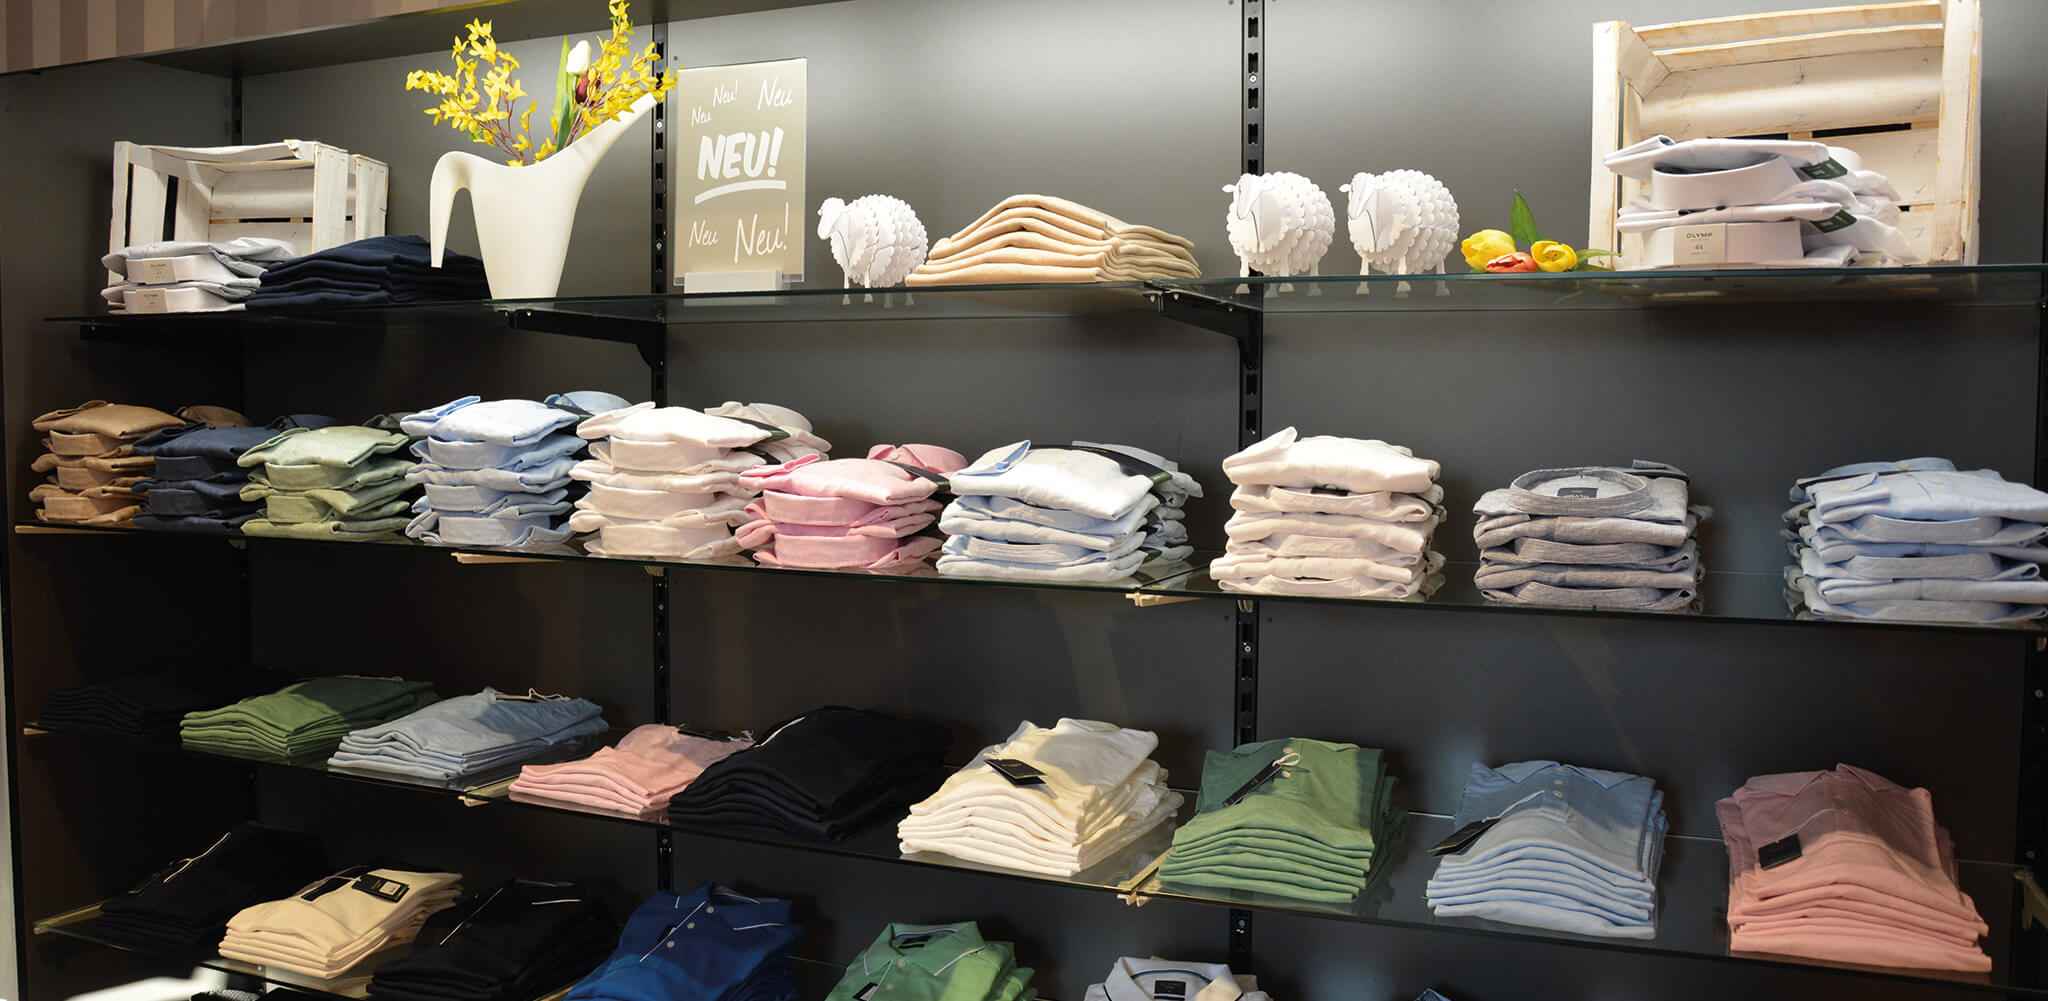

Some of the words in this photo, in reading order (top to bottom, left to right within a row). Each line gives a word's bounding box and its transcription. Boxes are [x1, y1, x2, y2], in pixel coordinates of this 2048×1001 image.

[712, 80, 738, 107] Neu!
[757, 76, 793, 110] Neu
[691, 106, 712, 128] Neu
[697, 126, 784, 181] NEU!
[688, 219, 719, 248] Neu
[734, 201, 789, 264] Neu!
